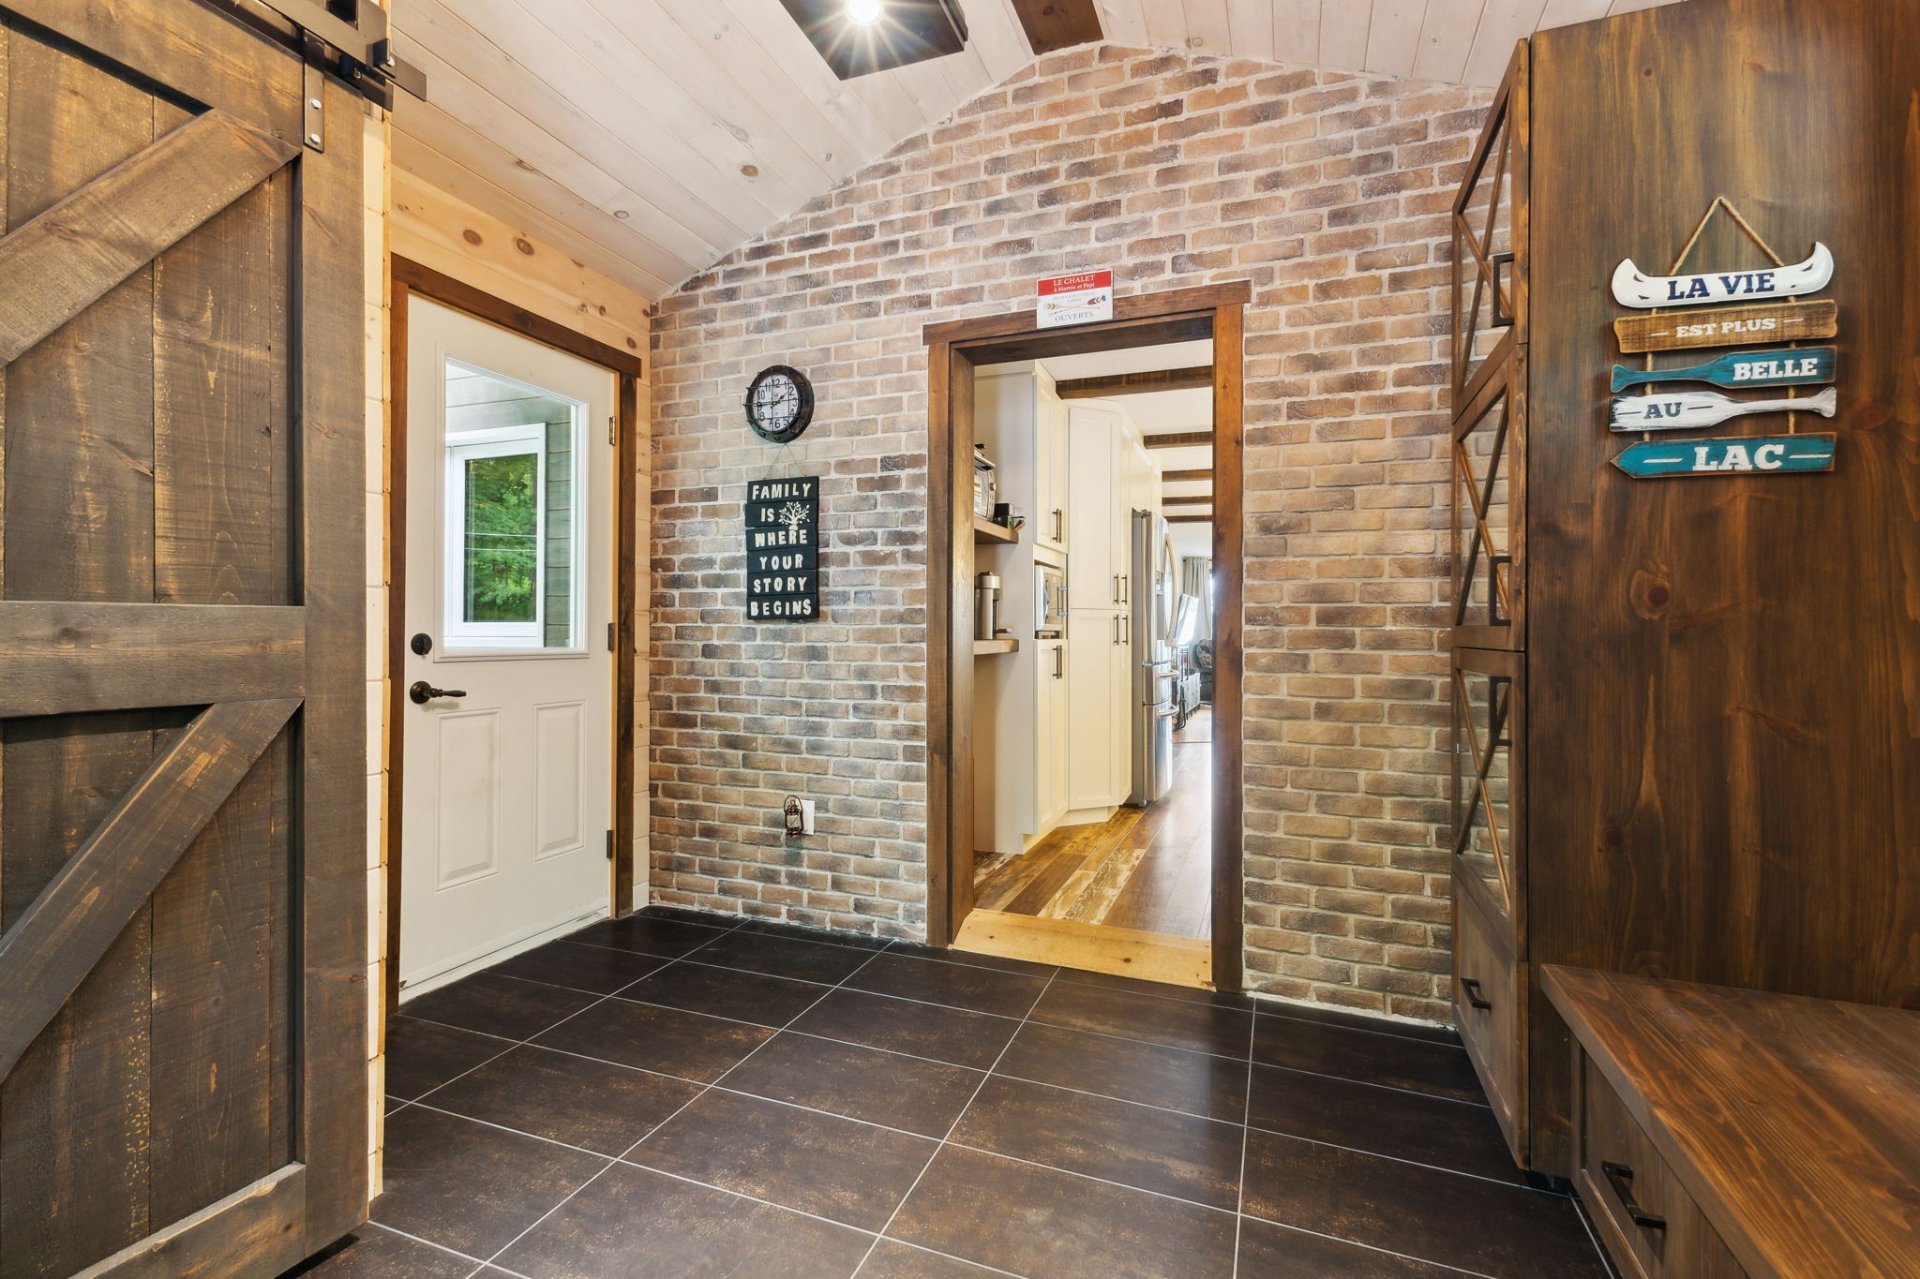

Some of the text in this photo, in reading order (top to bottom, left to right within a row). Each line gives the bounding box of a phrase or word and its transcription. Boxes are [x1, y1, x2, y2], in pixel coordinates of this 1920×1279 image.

[1064, 275, 1095, 284] CHALET
[1667, 272, 1775, 300] LA VIE
[1055, 311, 1094, 322] OUVERTS
[1676, 318, 1776, 338] EST PLUS
[1733, 358, 1818, 381] BELLE
[1643, 401, 1682, 420] AU
[774, 418, 780, 428] 6
[1692, 444, 1784, 472] LAC
[752, 482, 811, 500] FAMILY
[760, 507, 775, 522] IS
[754, 529, 808, 548] WHERE
[759, 553, 804, 570] YOUR
[753, 576, 807, 593] STORY
[750, 598, 812, 617] BEGINS
